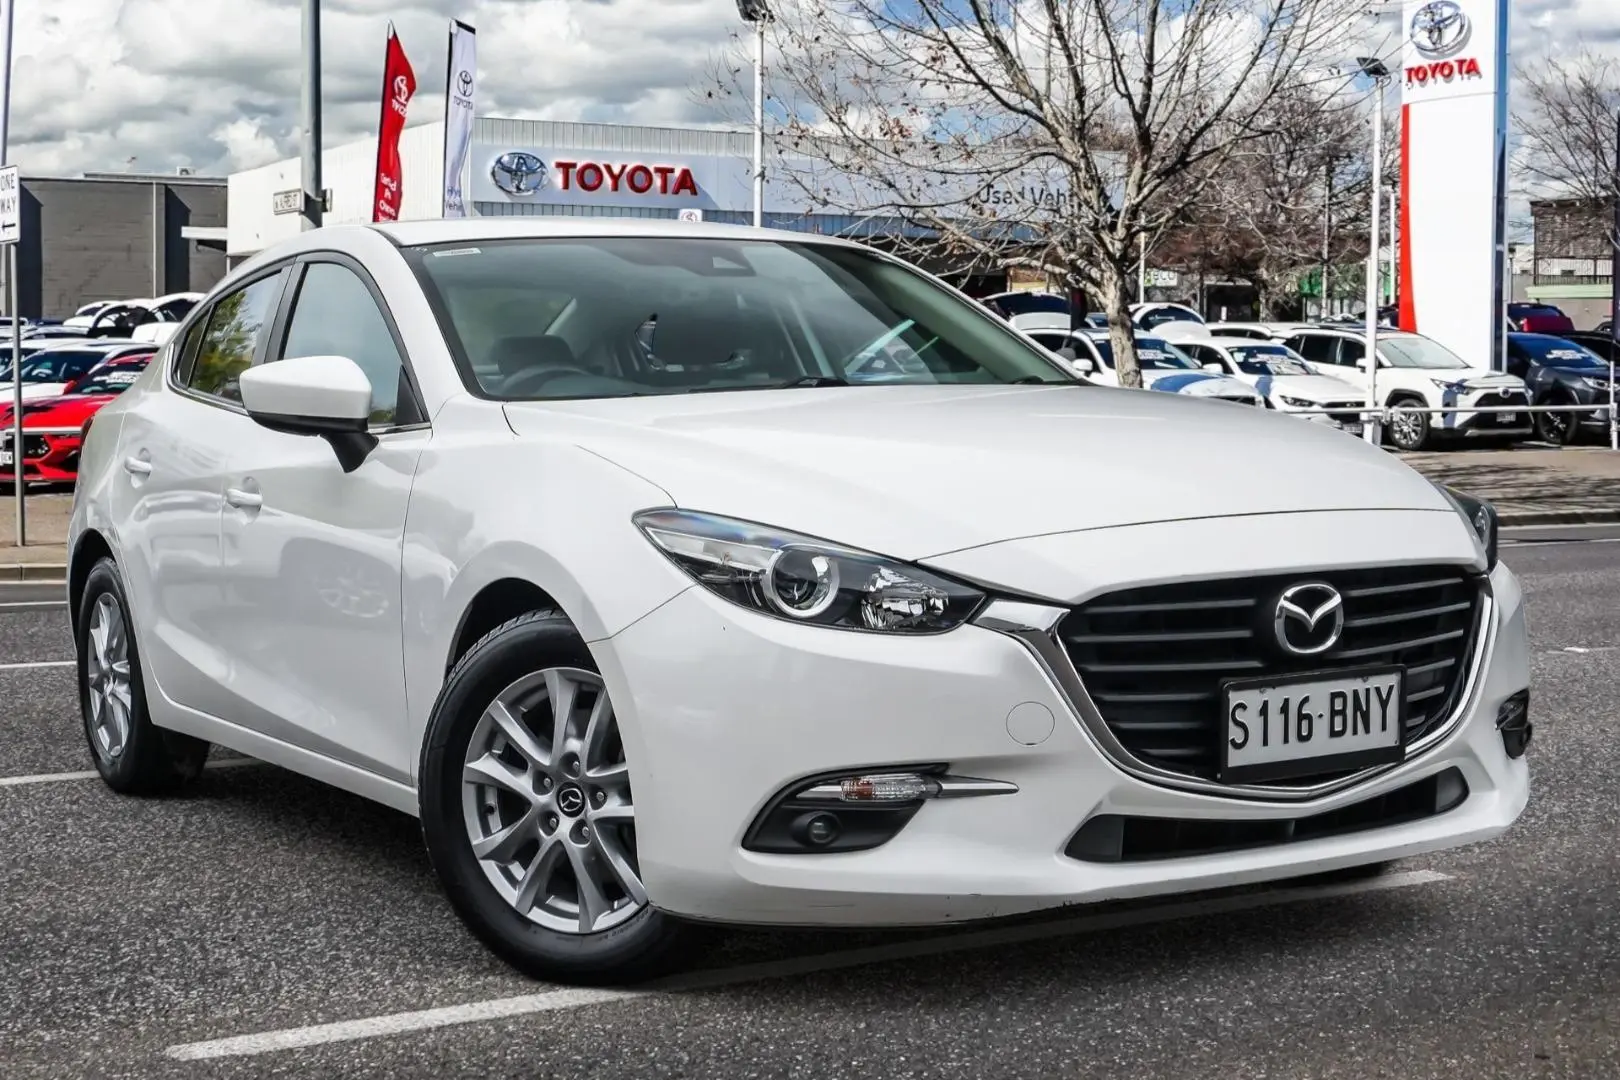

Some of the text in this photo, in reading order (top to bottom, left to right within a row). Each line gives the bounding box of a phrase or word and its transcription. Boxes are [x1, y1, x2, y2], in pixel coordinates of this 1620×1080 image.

[1404, 58, 1481, 82] TOYOTA
[1, 173, 15, 191] ONE
[555, 161, 698, 196] TOYOTA
[1, 196, 16, 214] WAY
